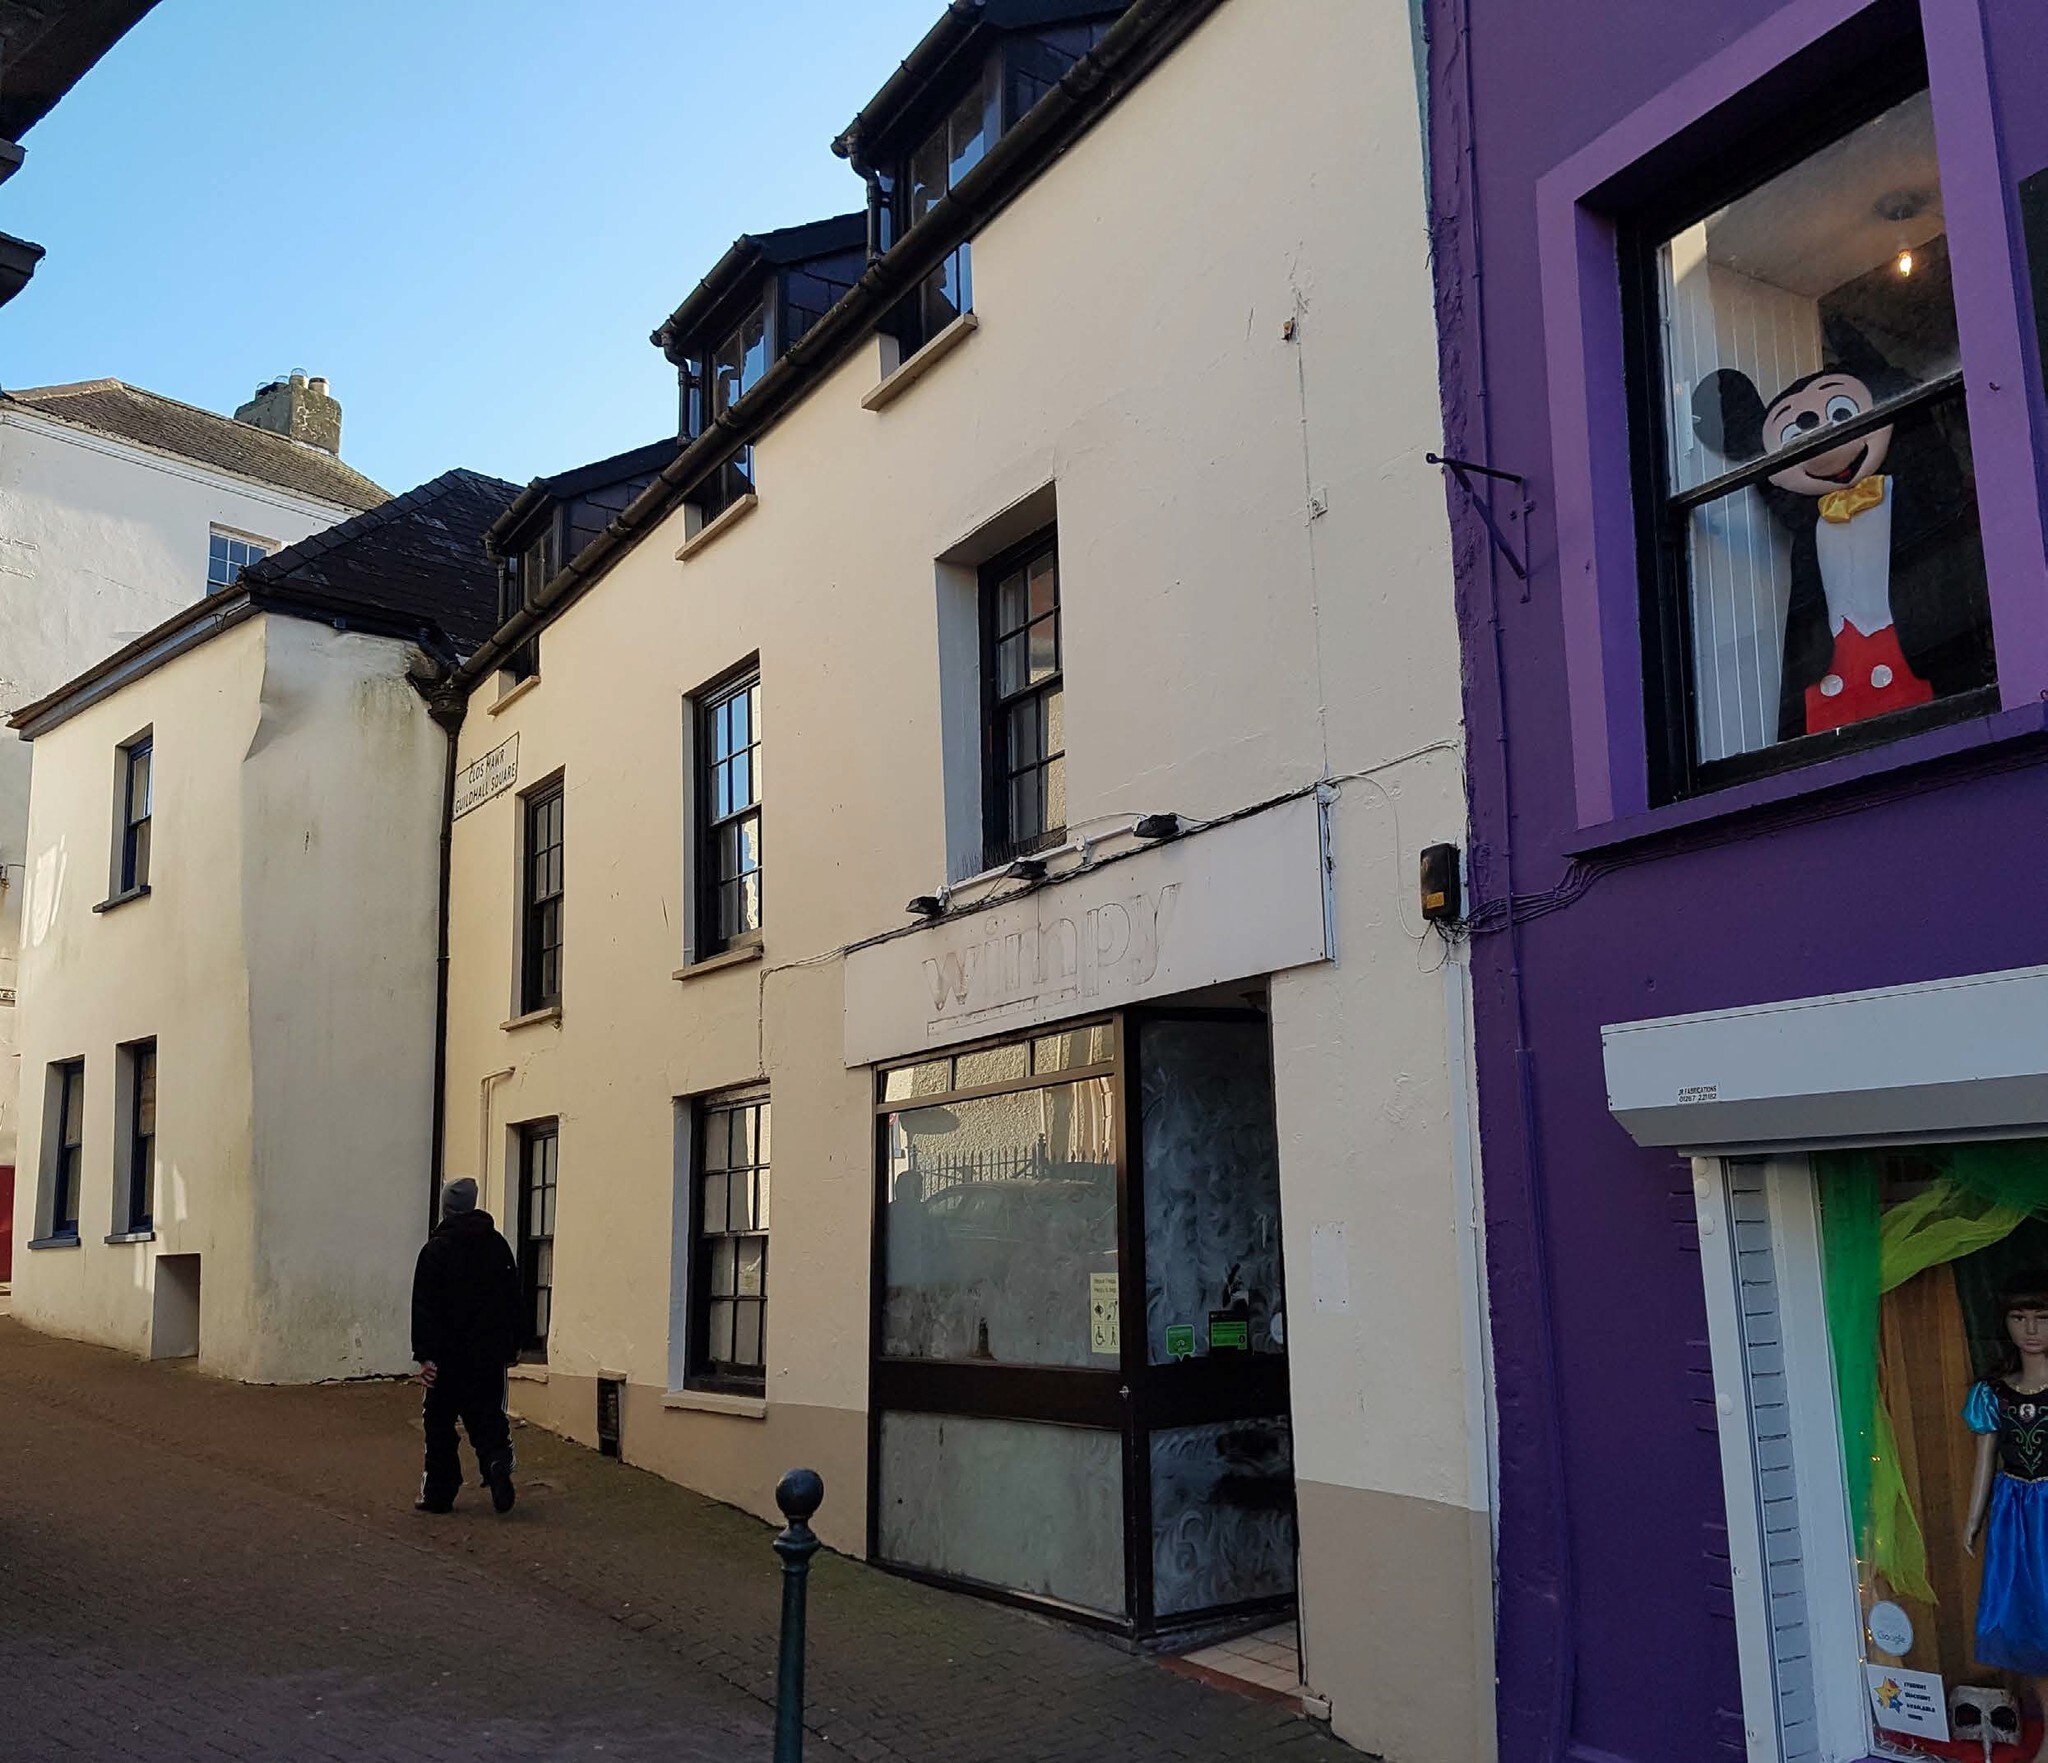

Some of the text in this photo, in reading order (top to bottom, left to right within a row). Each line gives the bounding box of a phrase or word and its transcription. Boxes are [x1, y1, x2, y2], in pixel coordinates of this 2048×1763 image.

[469, 749, 505, 784] CLOS MAWR
[456, 762, 516, 814] GUILDHALL SQUARE
[1876, 1630, 1907, 1645] Google
